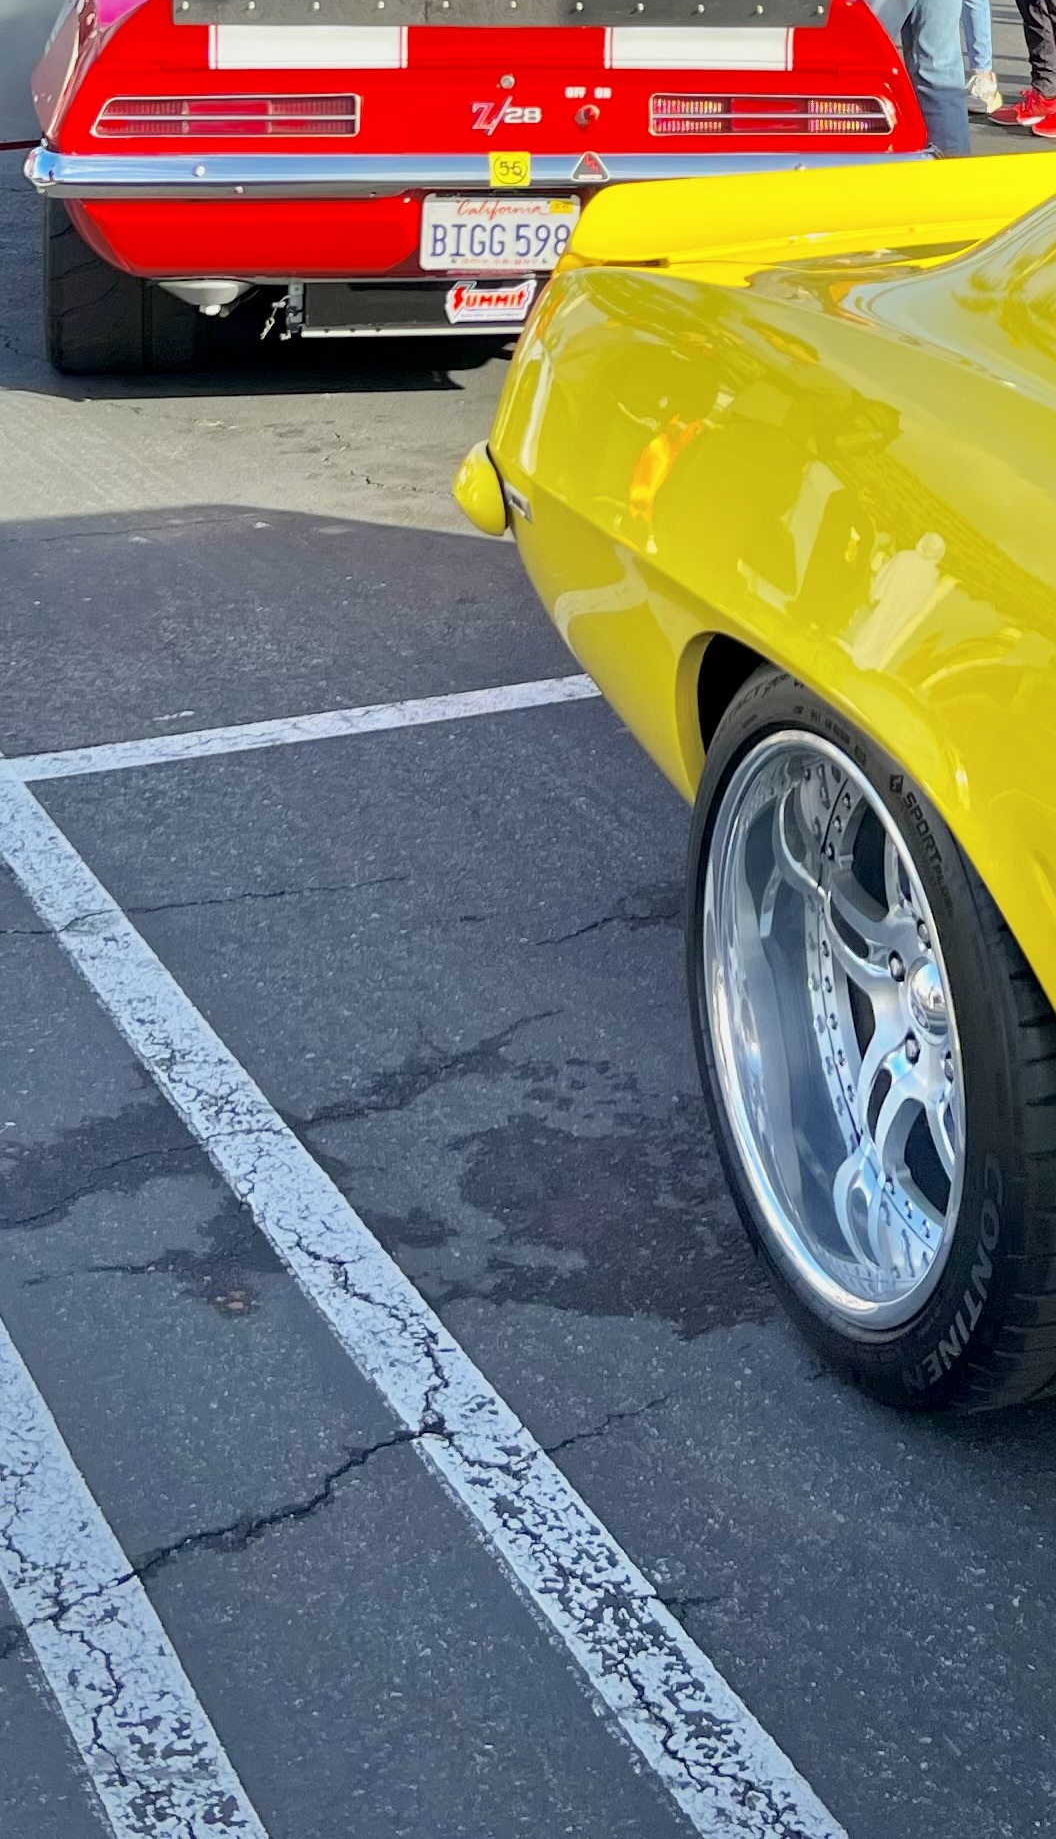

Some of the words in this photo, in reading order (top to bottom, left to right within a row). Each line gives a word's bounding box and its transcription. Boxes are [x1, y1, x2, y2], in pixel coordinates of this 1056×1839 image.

[456, 198, 550, 221] California
[430, 223, 507, 258] BIGG
[514, 223, 571, 258] 598
[902, 791, 943, 862] SPORT
